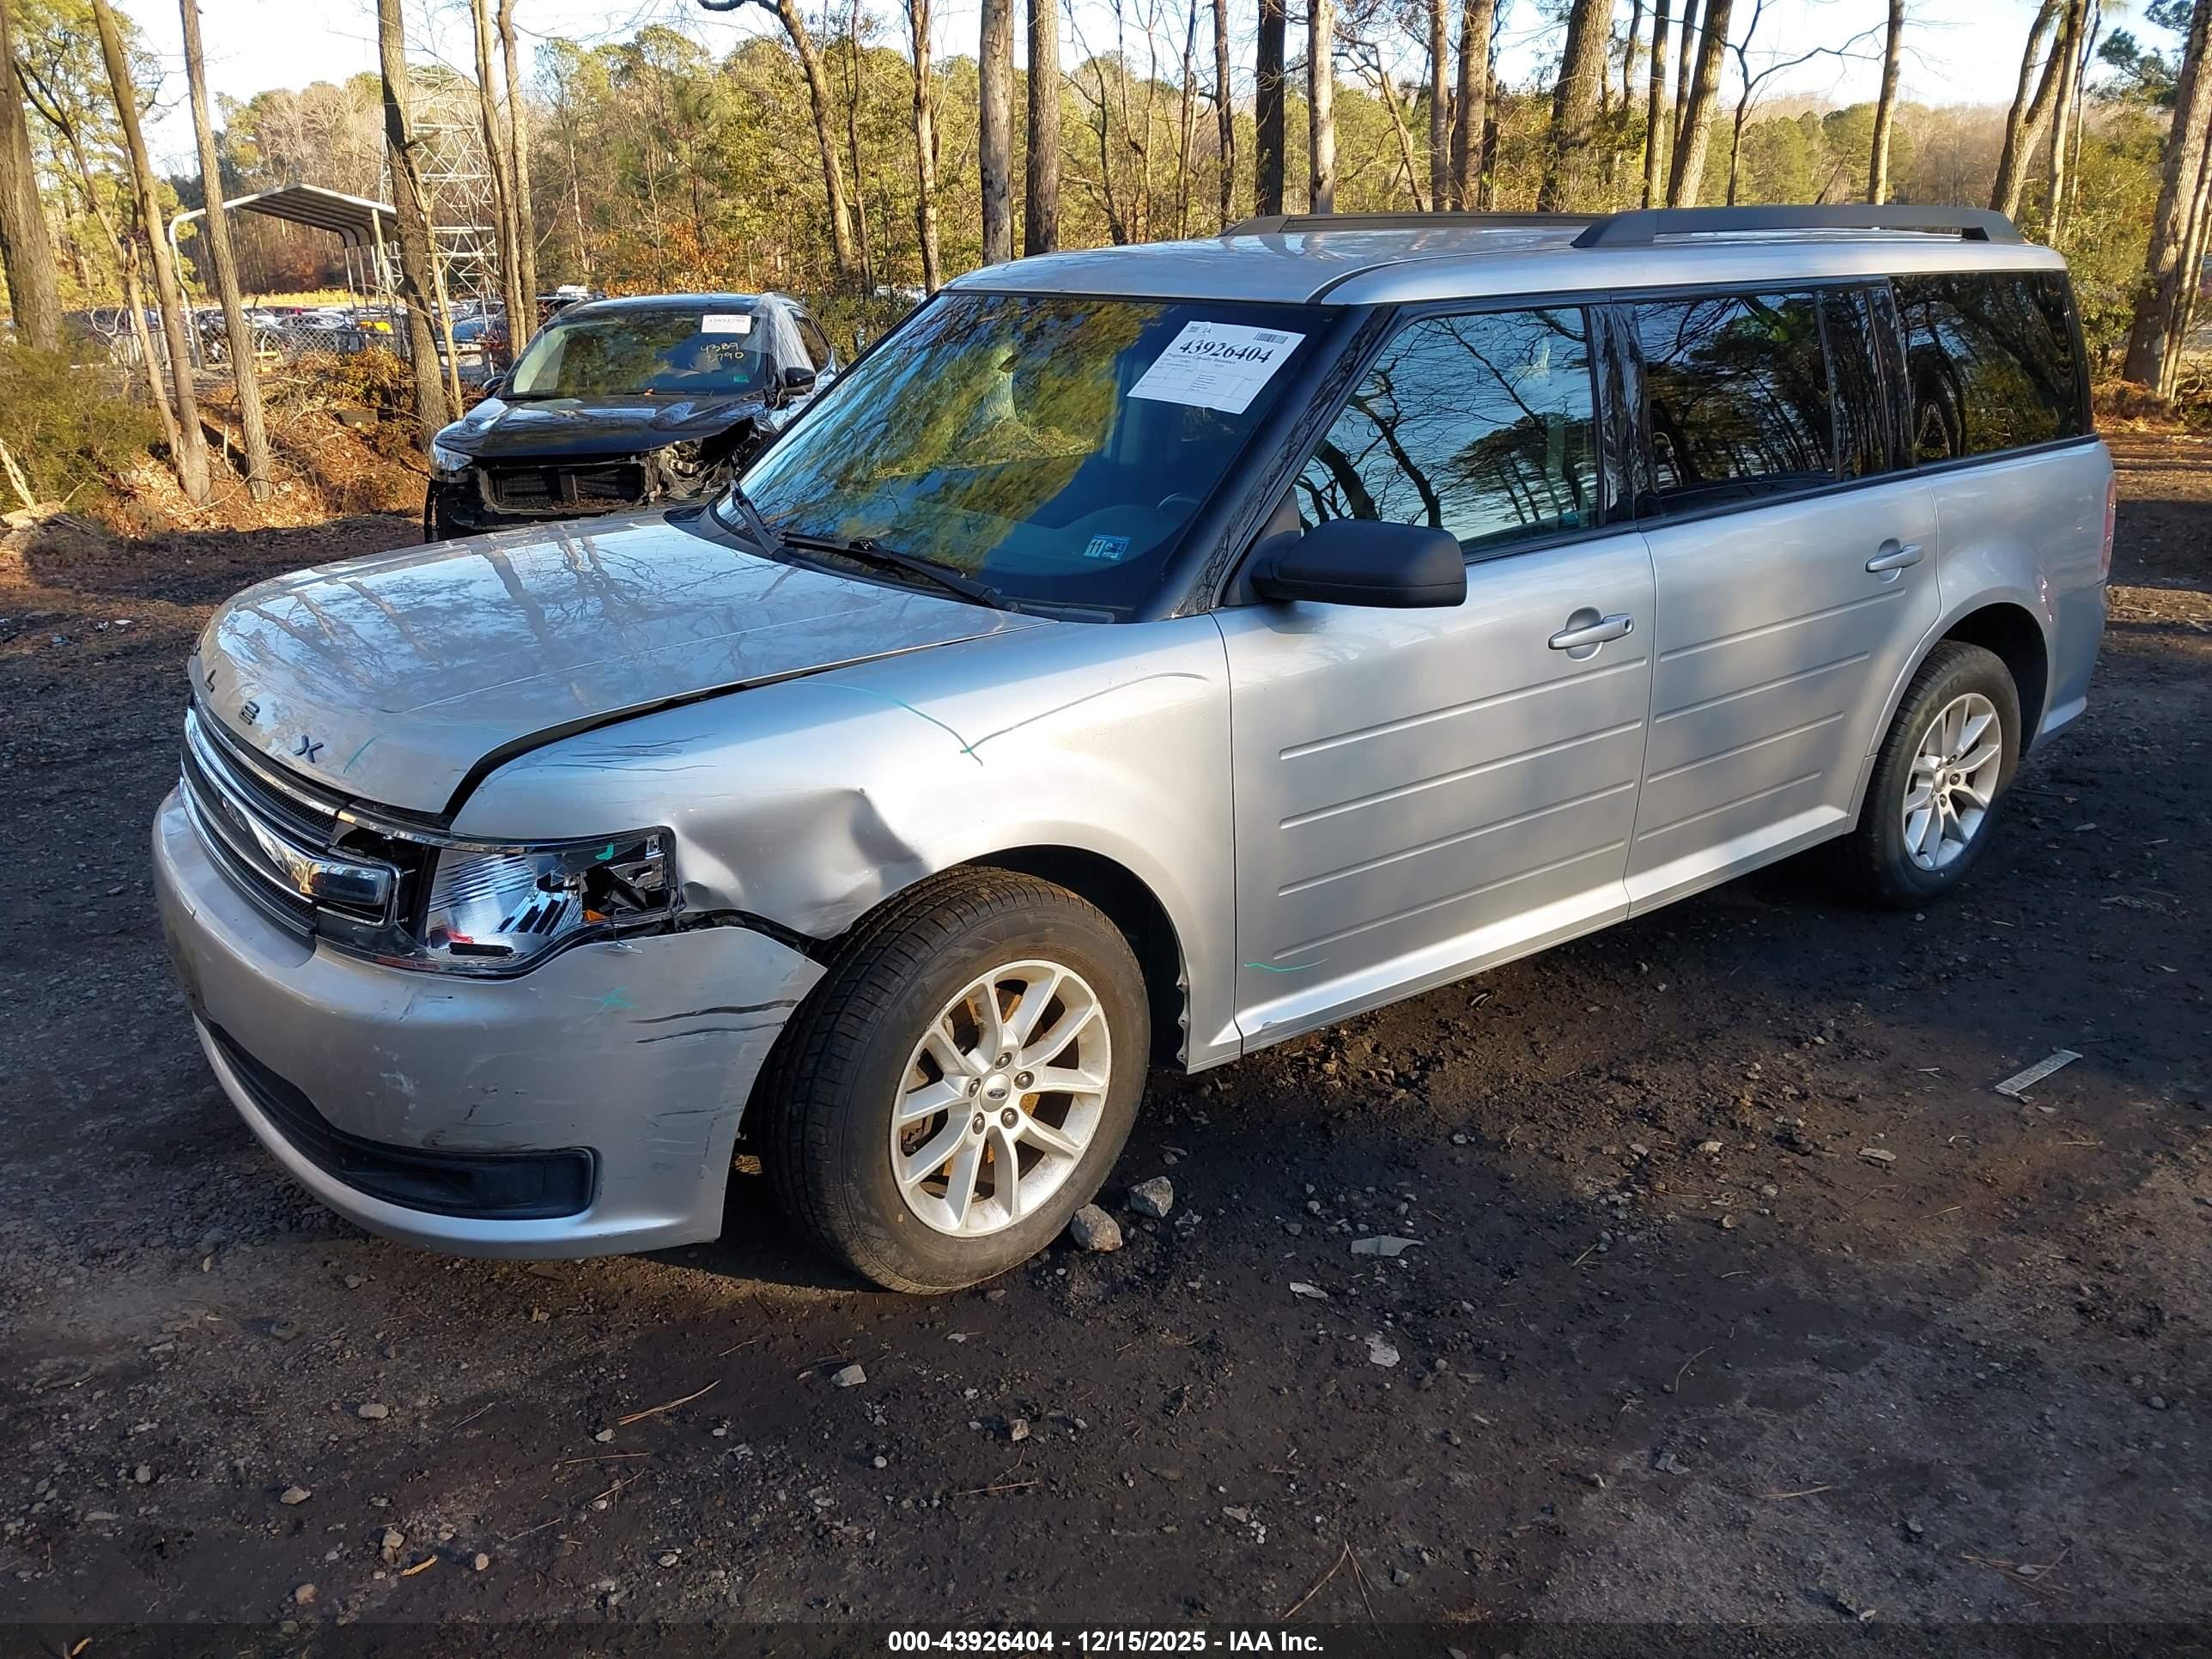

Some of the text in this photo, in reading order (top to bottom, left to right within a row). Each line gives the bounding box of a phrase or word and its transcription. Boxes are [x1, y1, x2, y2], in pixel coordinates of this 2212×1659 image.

[700, 342, 738, 354] 4389
[1179, 339, 1275, 363] 43926404
[706, 351, 744, 363] 2790
